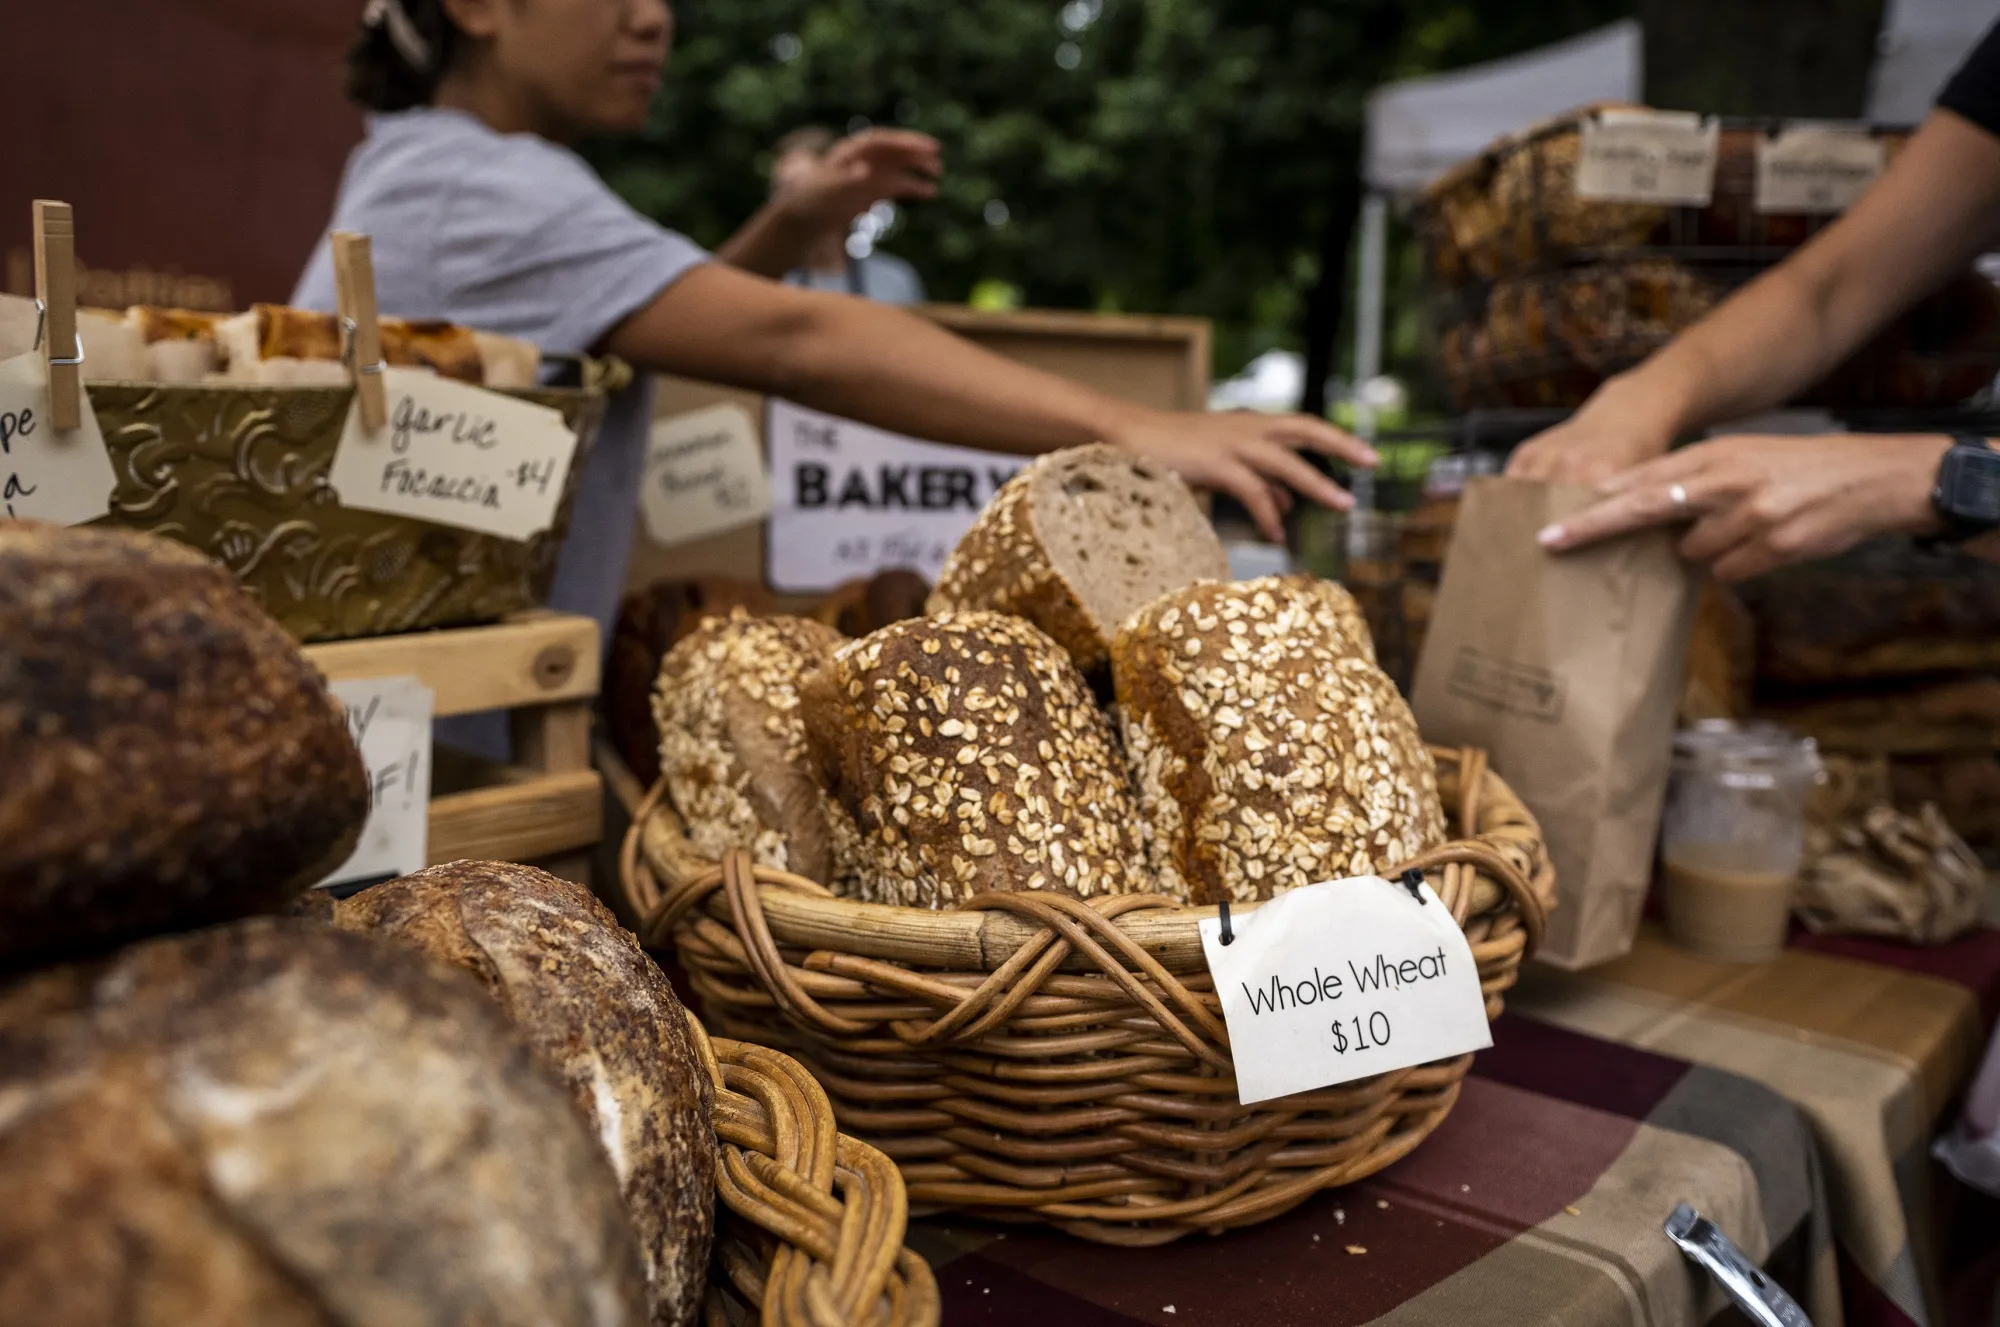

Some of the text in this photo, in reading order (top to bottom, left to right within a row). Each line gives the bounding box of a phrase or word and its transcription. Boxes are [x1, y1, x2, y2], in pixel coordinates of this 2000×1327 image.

[381, 458, 502, 509] Focaccia
[1242, 947, 1447, 1015] Whole Wheat
[1331, 1010, 1391, 1054] $10
